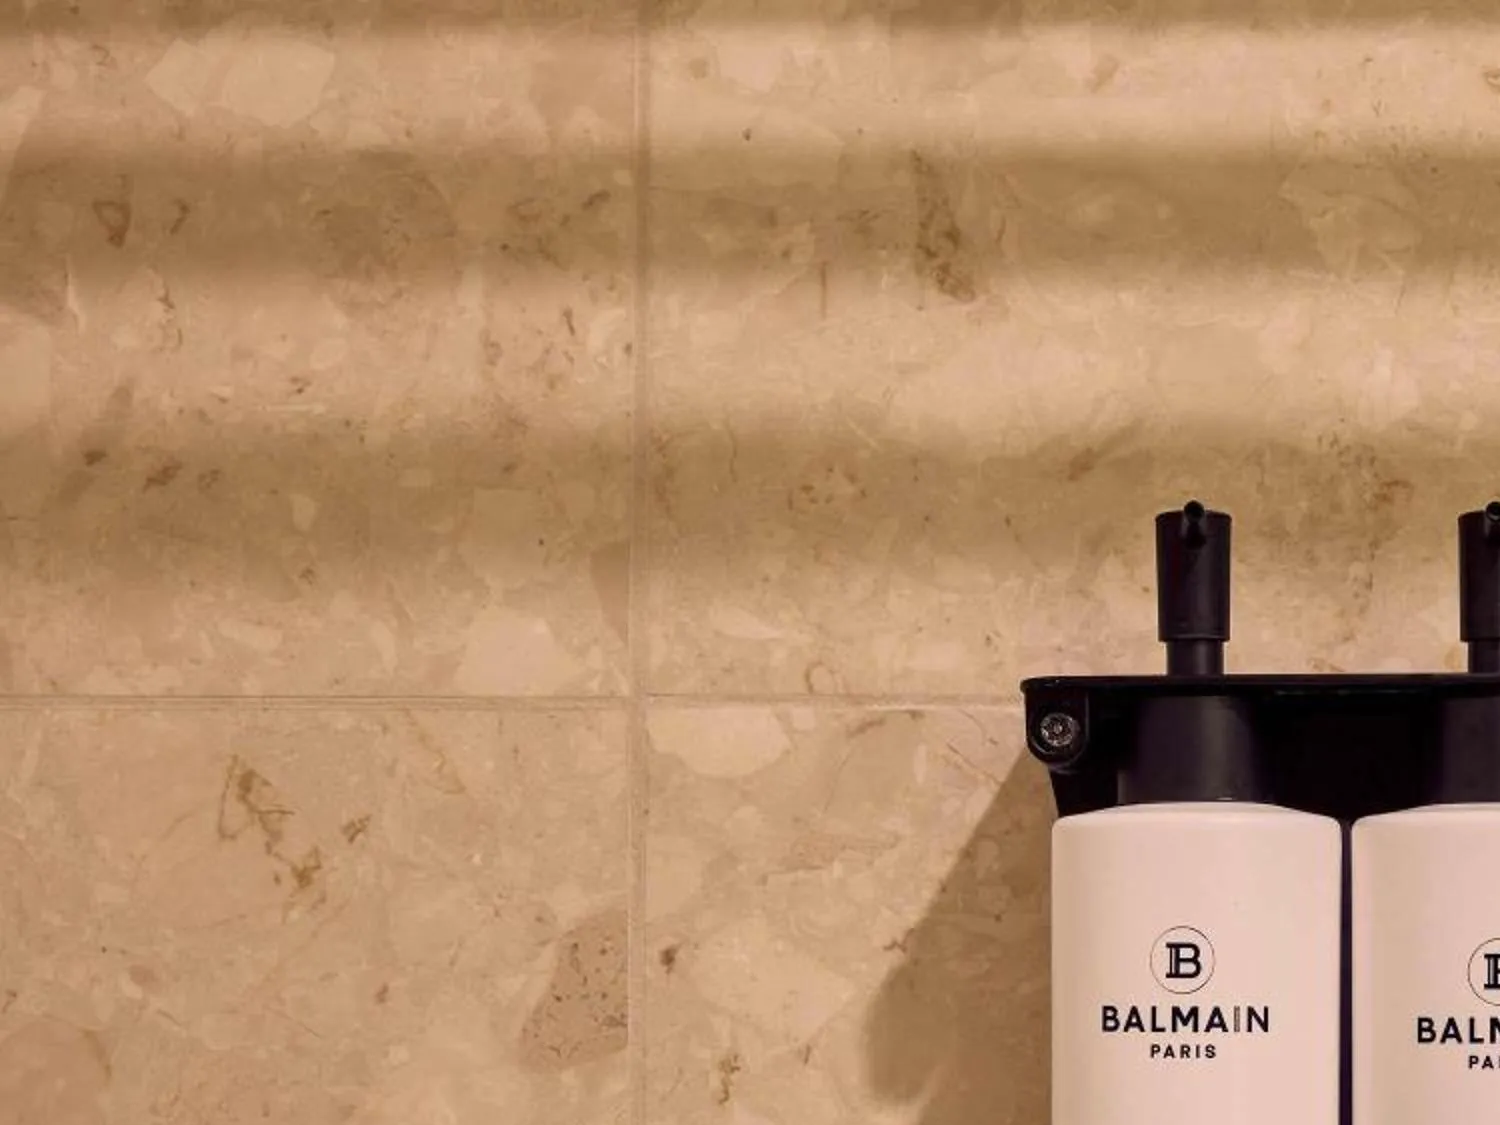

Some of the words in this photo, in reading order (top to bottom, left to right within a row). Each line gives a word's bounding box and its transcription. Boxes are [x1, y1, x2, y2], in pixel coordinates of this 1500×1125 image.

[1165, 942, 1202, 979] B
[1101, 1004, 1270, 1034] BALMAIN
[1149, 1043, 1217, 1059] PARIS
